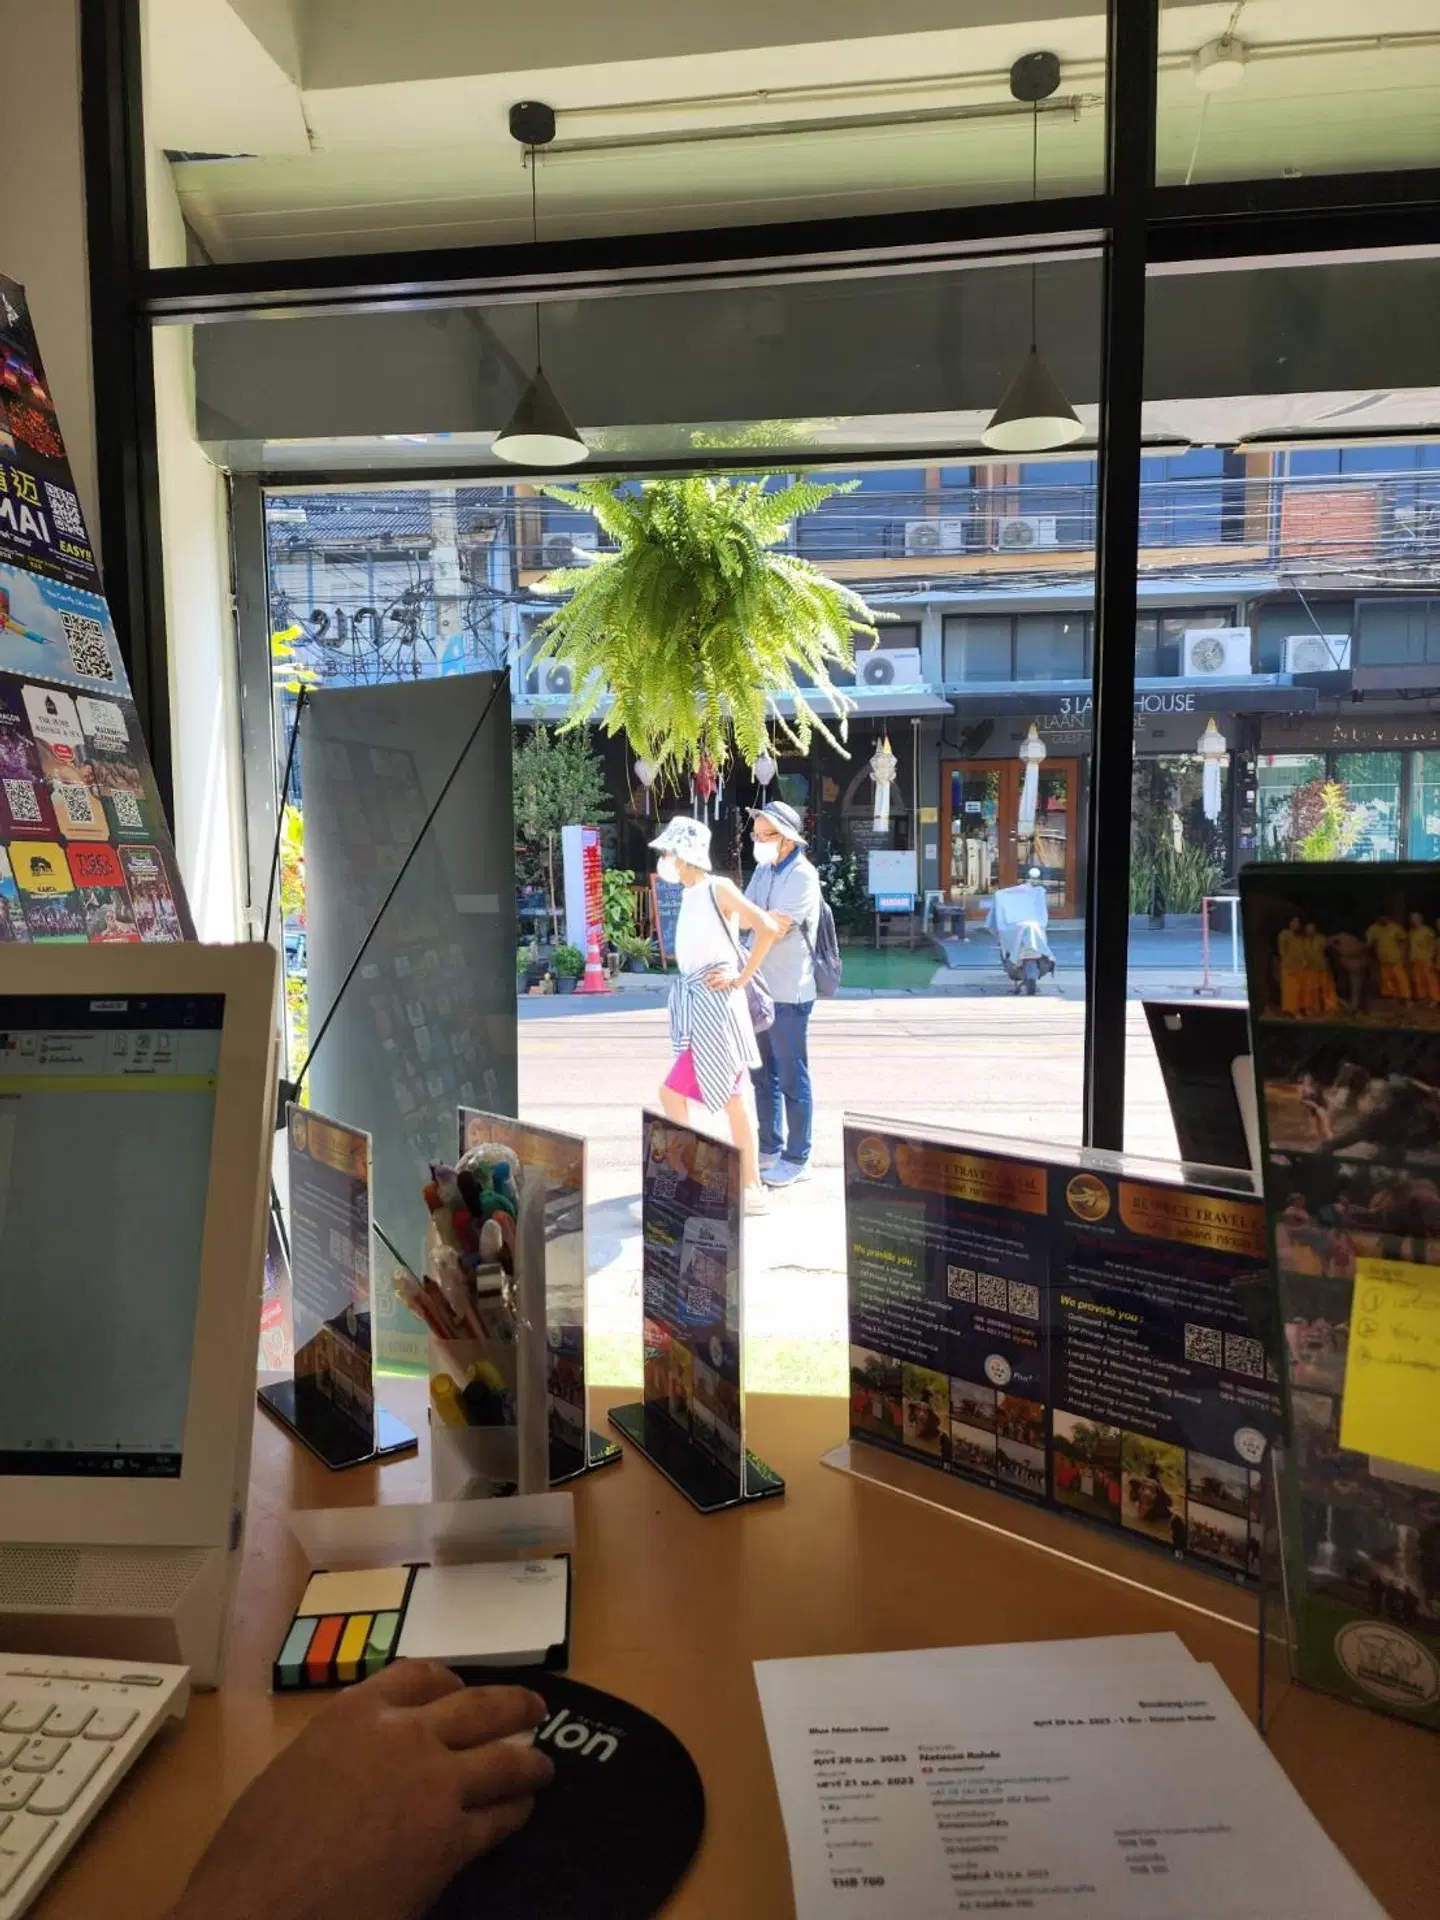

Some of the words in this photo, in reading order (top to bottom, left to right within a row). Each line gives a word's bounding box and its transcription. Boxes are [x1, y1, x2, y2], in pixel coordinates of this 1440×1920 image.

[1060, 697, 1071, 713] 3
[1134, 694, 1196, 712] HOUSE
[1061, 1295, 1076, 1307] We
[1077, 1299, 1117, 1316] provide
[1118, 1308, 1139, 1322] you
[880, 1754, 908, 1763] 2023
[887, 1776, 915, 1786] 2023
[832, 1876, 859, 1889] THB
